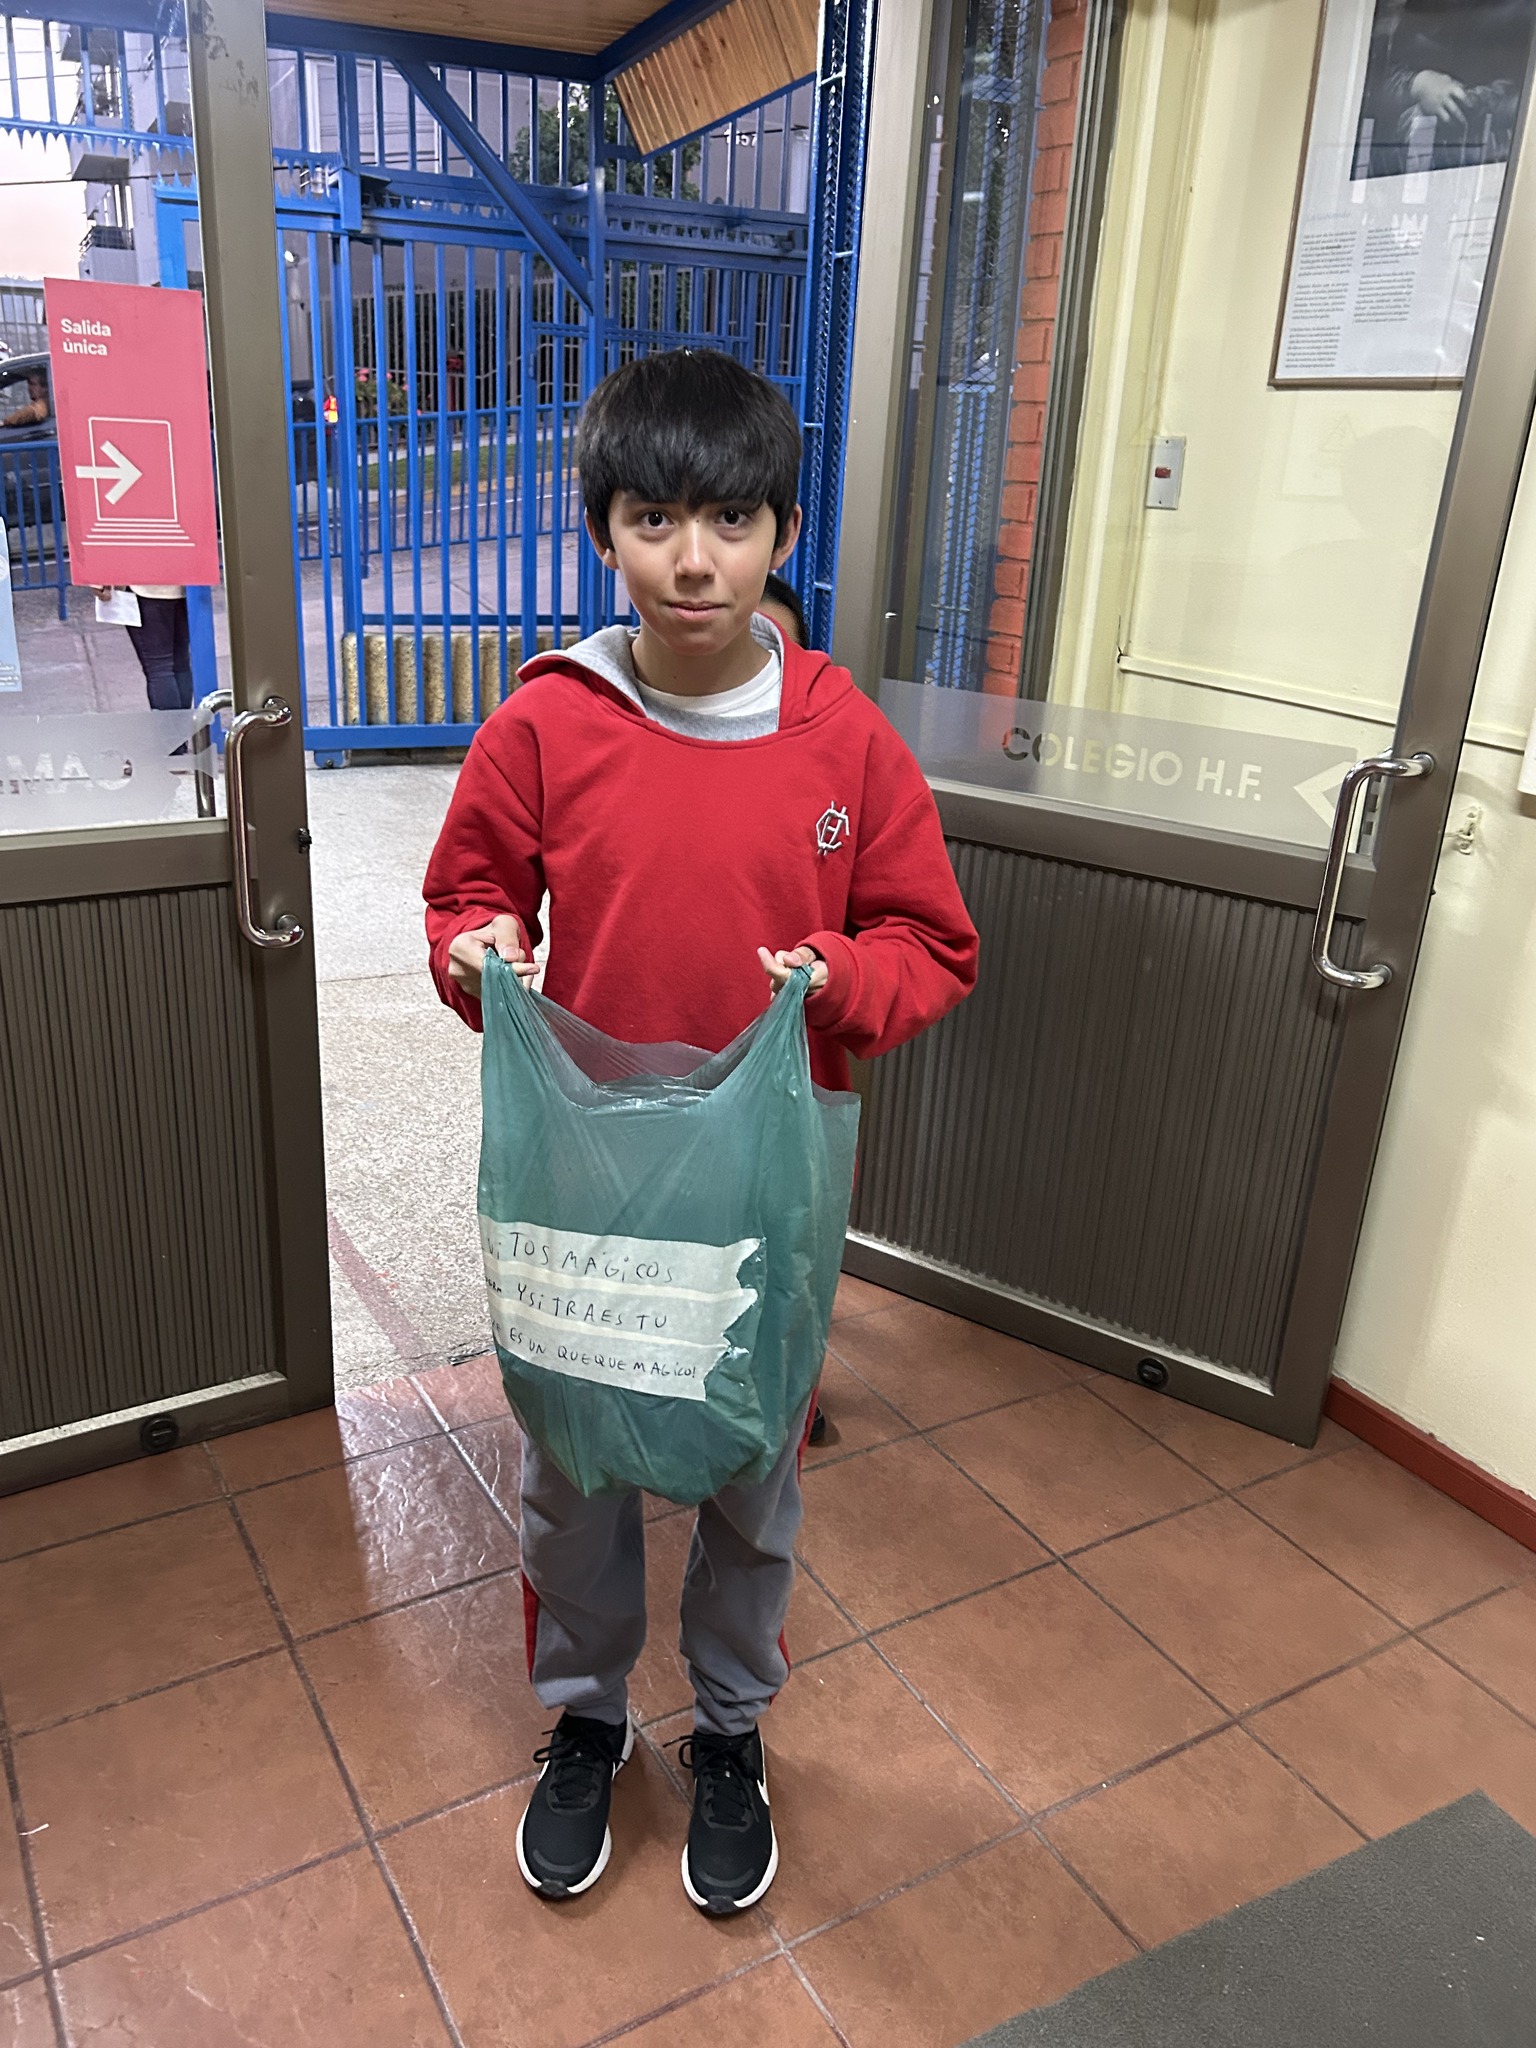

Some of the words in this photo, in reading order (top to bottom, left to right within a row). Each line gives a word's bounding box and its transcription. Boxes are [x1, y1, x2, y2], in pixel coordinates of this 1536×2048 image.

[61, 318, 111, 337] Salida
[63, 338, 108, 356] única
[1002, 727, 1183, 787] COLEGIO
[1196, 757, 1262, 801] H.F.
[552, 1297, 623, 1326] TRAES
[637, 1315, 667, 1330] TU
[510, 1327, 522, 1344] ES
[529, 1339, 546, 1355] UN
